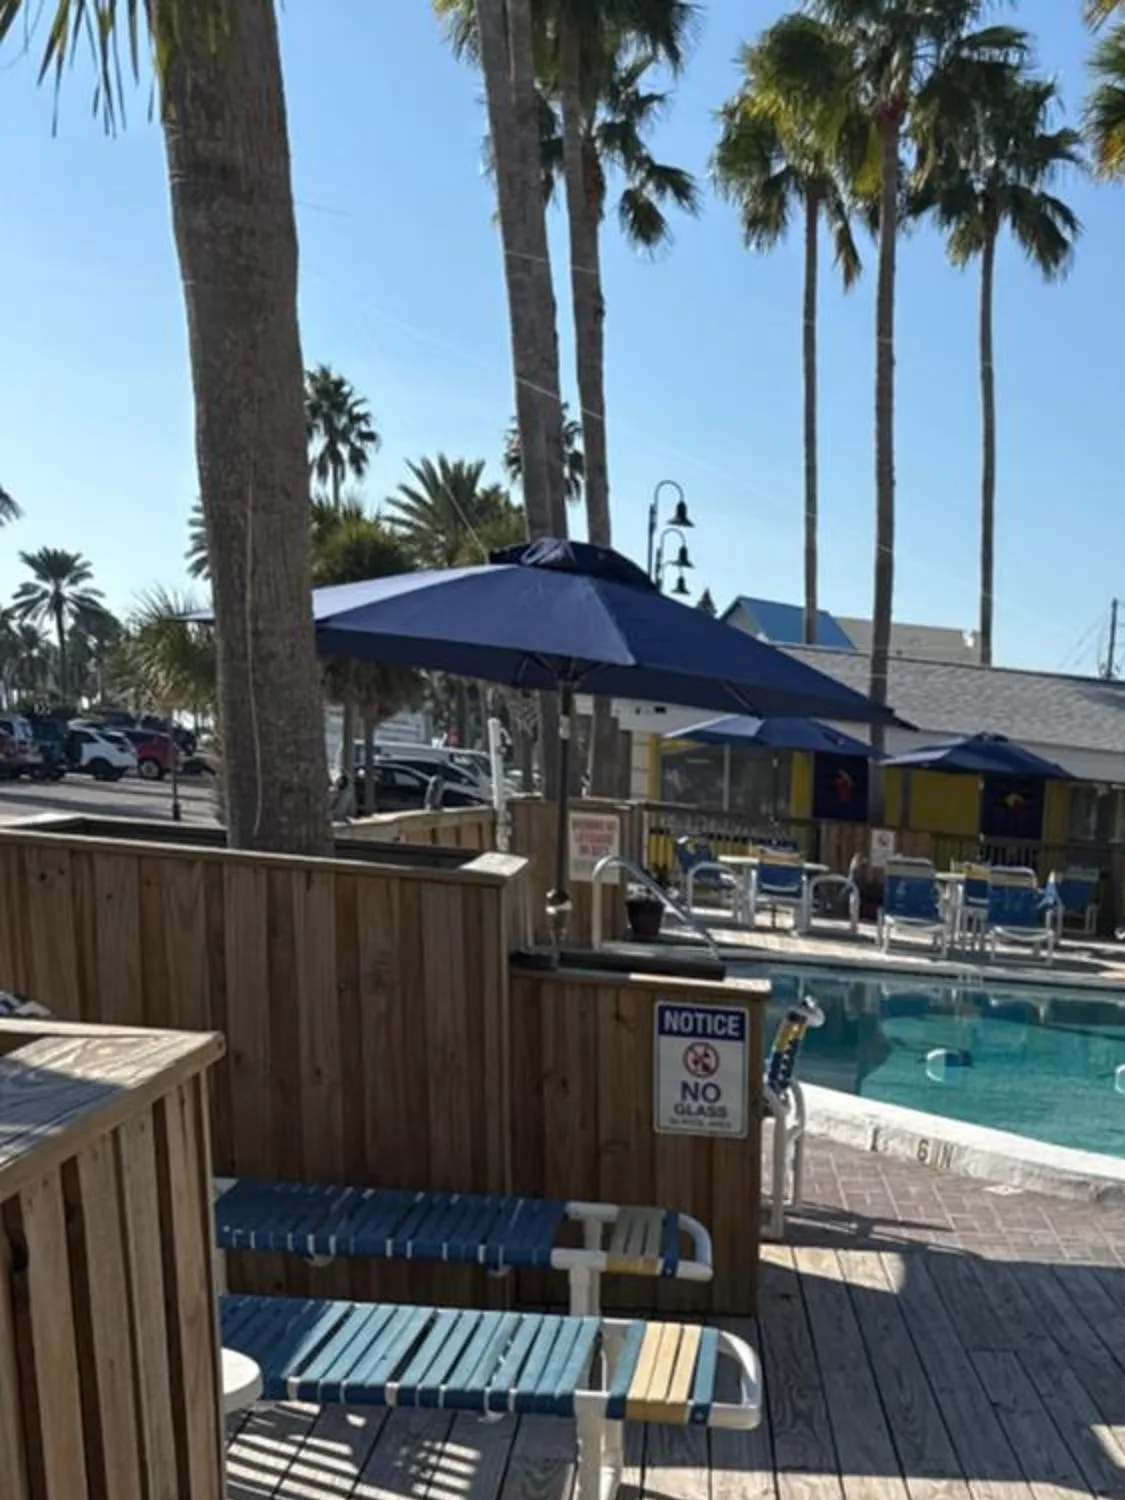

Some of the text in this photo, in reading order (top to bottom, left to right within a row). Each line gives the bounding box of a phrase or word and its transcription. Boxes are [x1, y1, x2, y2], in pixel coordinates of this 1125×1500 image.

[663, 1009, 740, 1037] NOTICE
[681, 1081, 721, 1103] NO
[673, 1102, 728, 1118] GLASS
